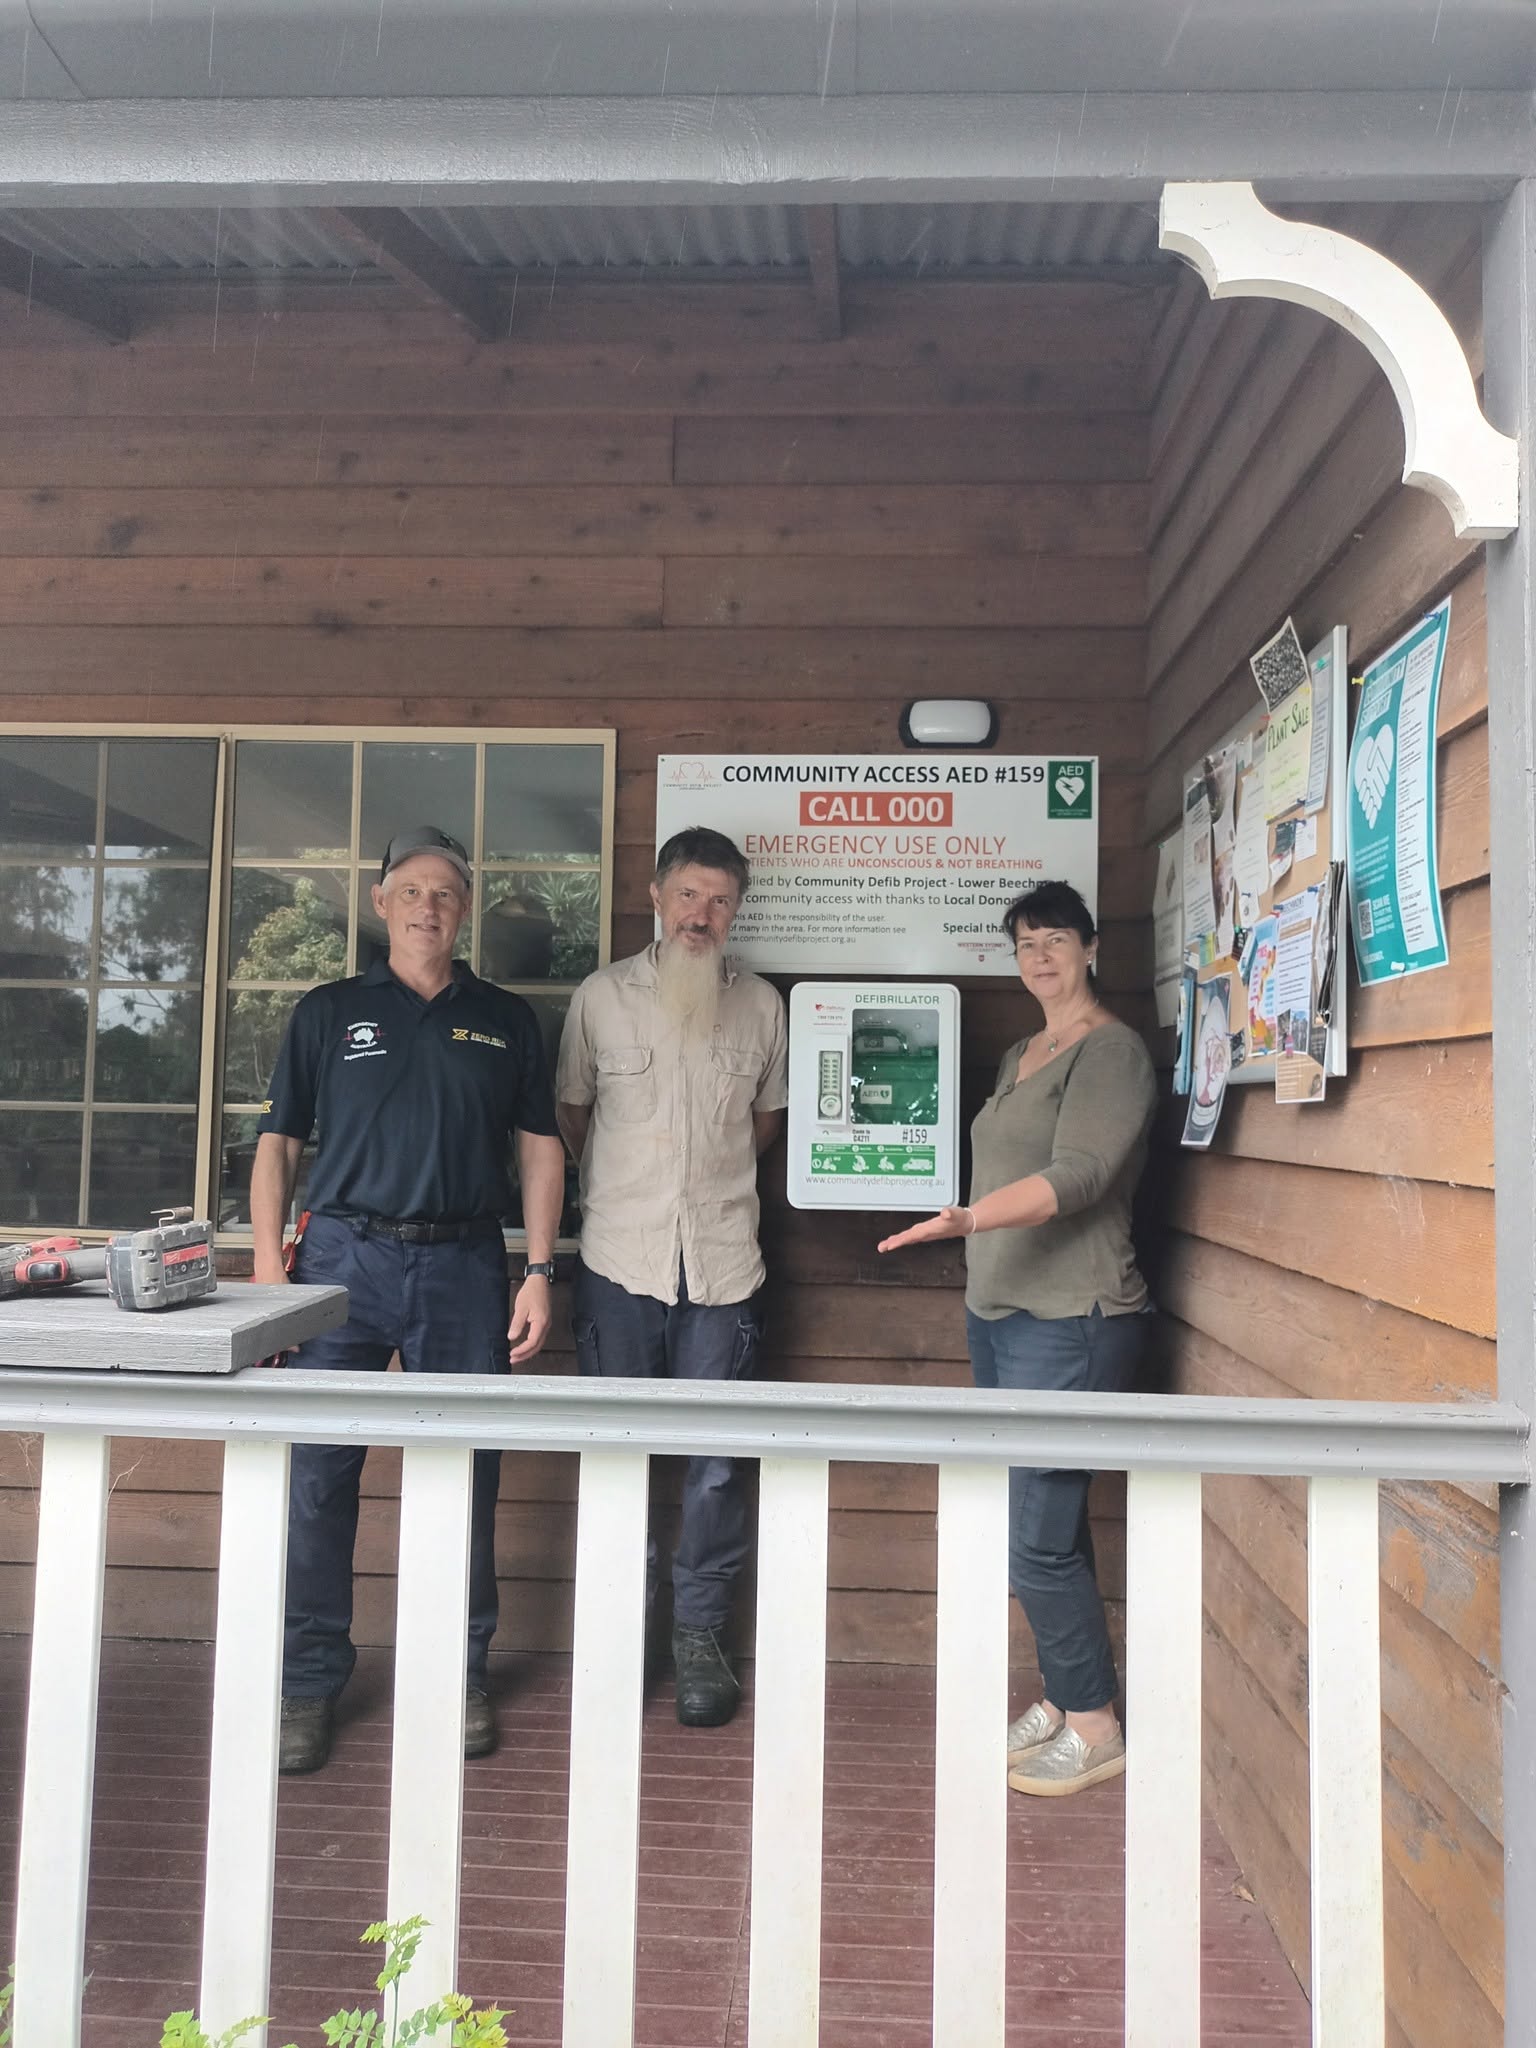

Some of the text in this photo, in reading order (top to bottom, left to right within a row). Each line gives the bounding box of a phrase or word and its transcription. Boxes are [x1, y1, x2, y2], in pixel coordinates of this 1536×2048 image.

[722, 765, 1045, 783] COMMUNITY ACCESS AED #159
[1057, 765, 1085, 776] AED
[808, 796, 944, 823] CALL 000
[745, 834, 1006, 855] EMERGENCY USE ONLY
[749, 857, 1043, 870] TIENTS WHO ARE UNCONSCIOUS & NOT BREATHING
[777, 875, 792, 889] by
[794, 876, 865, 889] Community
[868, 876, 901, 888] Defib
[905, 877, 947, 890] Project
[958, 878, 995, 889] Lower
[745, 894, 812, 905] community
[815, 896, 853, 905] access
[856, 894, 883, 905] with
[886, 894, 926, 905] thanks
[929, 896, 940, 905] to
[944, 895, 974, 906] Local
[748, 913, 764, 921] AED
[773, 913, 787, 921] the
[788, 913, 841, 923] responsibility
[842, 914, 850, 922] of
[852, 914, 866, 922] the
[771, 925, 785, 933] the
[807, 925, 820, 933] For
[845, 925, 891, 934] information
[943, 922, 1008, 934] Special tha
[855, 994, 940, 1005] DEFIBRILLATOR
[902, 1128, 928, 1144] #159
[805, 1176, 945, 1187] www.communitydefibproject.org.au
